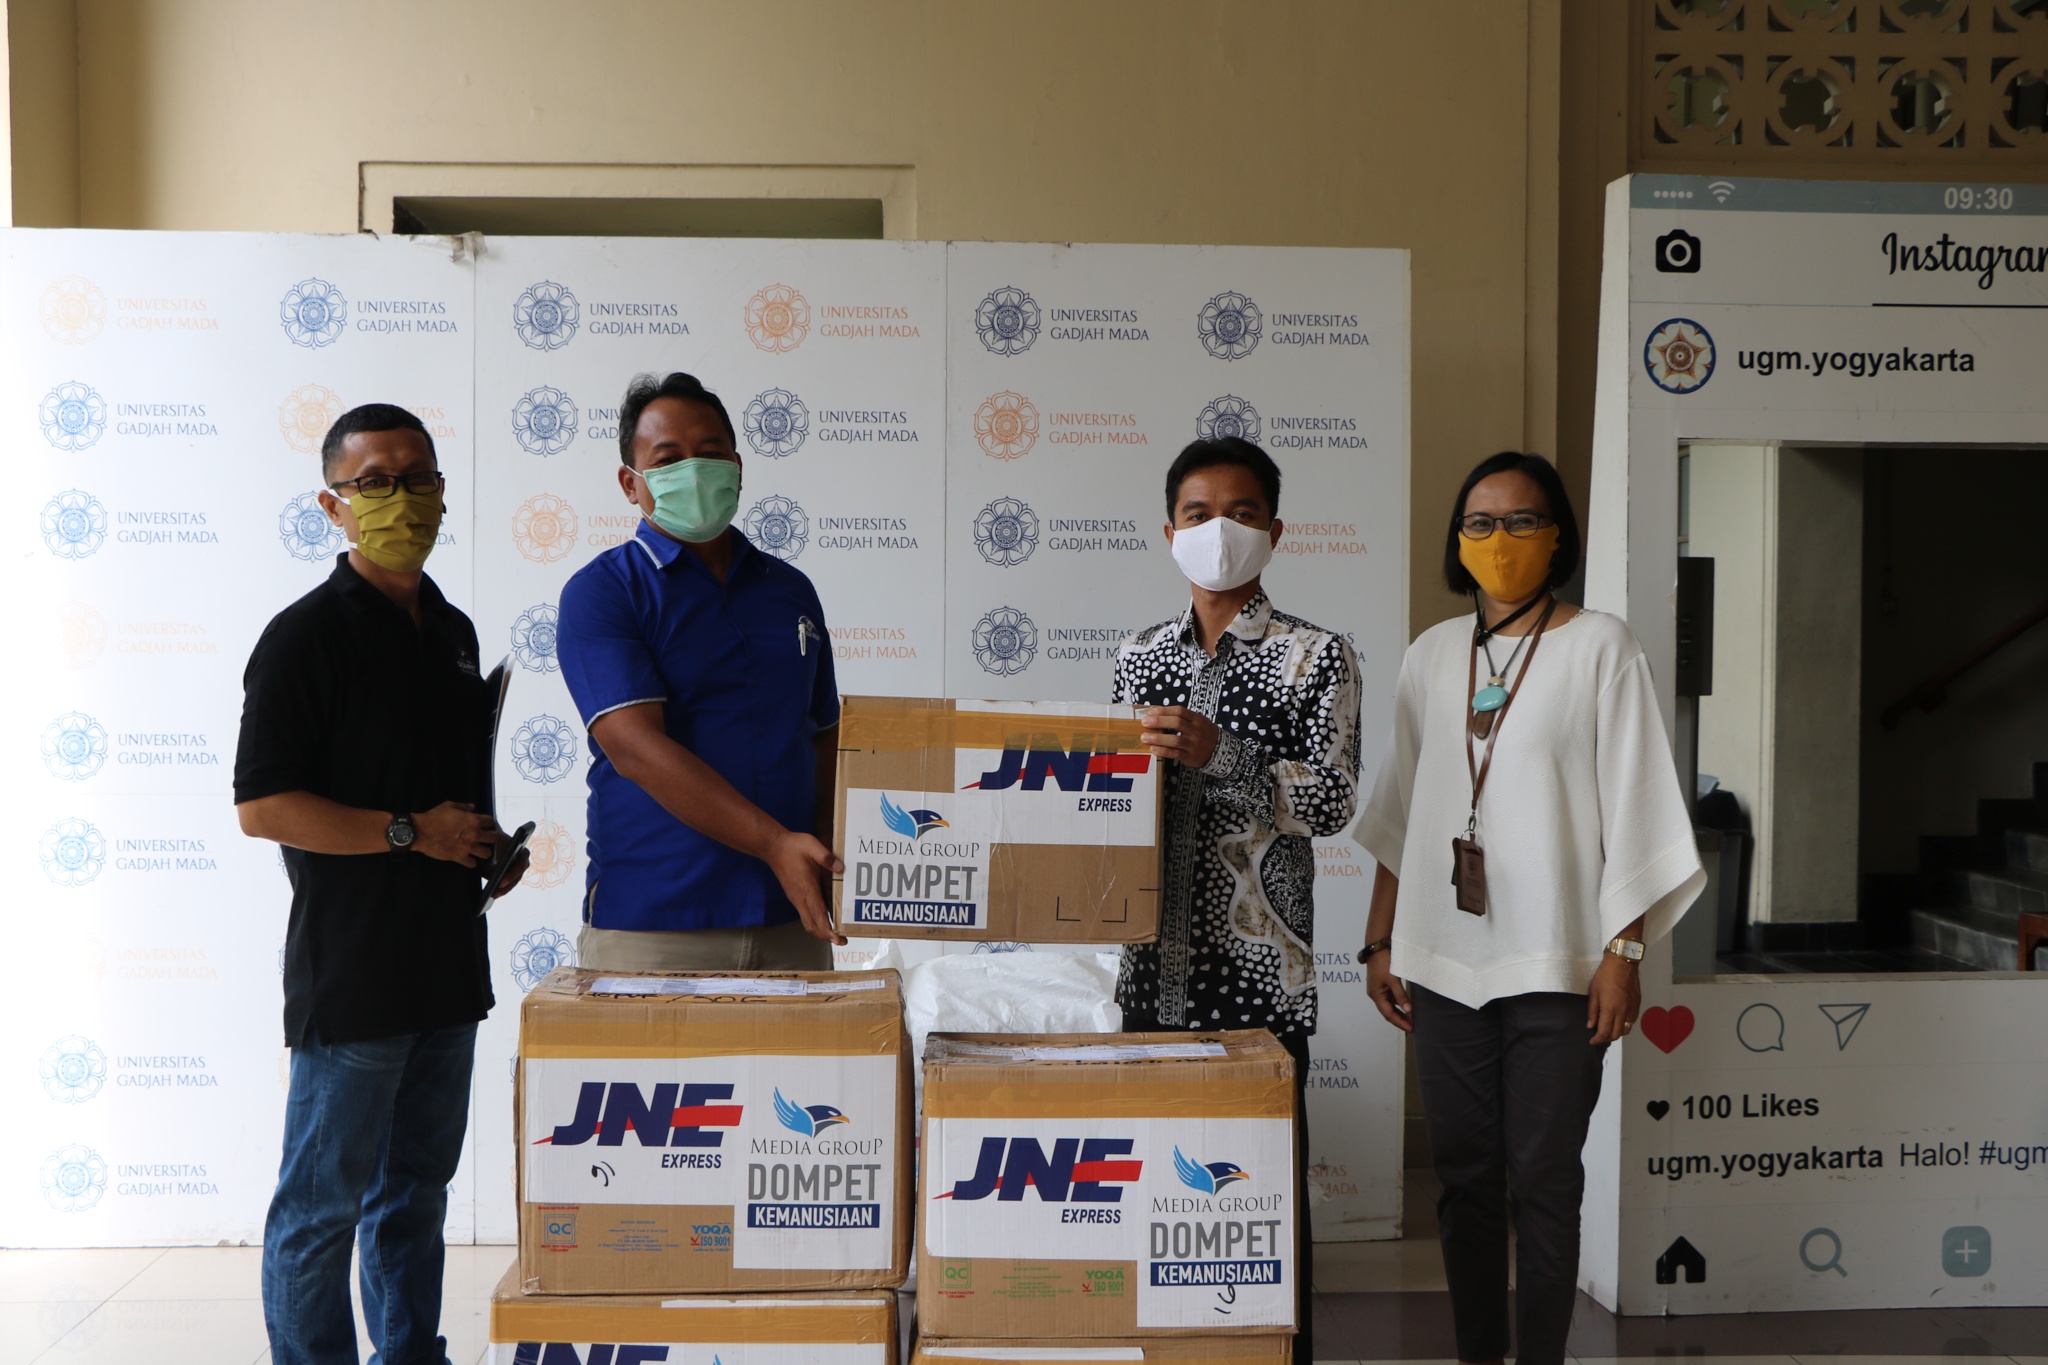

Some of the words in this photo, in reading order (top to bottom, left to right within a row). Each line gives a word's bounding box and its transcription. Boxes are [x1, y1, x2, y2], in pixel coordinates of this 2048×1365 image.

[1944, 187, 2013, 210] 09:30
[117, 298, 207, 313] UNIVERSITAS
[357, 301, 446, 314] UNIVERSITAS
[590, 303, 678, 317] UNIVERSITAS
[820, 306, 909, 320] UNIVERSITAS
[117, 316, 172, 331] GADJAH
[178, 316, 219, 331] MADA
[1051, 309, 1138, 323] UNIVERSITAS
[1272, 313, 1358, 328] UNIVERSITAS
[356, 319, 412, 335] GADJAH
[416, 319, 458, 333] MADA
[589, 321, 644, 337] GADJAH
[649, 322, 690, 335] MADA
[819, 323, 874, 339] GADJAH
[879, 324, 920, 338] MADA
[1050, 326, 1104, 343] GADJAH
[1109, 327, 1150, 341] MADA
[1271, 331, 1325, 347] GADJAH
[1329, 332, 1370, 346] MADA
[1738, 347, 1975, 377] ugm.yogyakarta
[117, 404, 206, 417] UNIVERSITAS
[819, 410, 907, 424] UNIVERSITAS
[1049, 413, 1137, 427] UNIVERSITAS
[1271, 417, 1357, 431] UNIVERSITAS
[116, 422, 172, 437] GADJAH
[177, 422, 218, 436] MADA
[427, 425, 457, 438] ADA
[818, 428, 873, 444] GADJAH
[878, 429, 919, 442] MADA
[1048, 431, 1103, 447] GADJAH
[1107, 431, 1148, 445] MADA
[1270, 434, 1323, 451] GADJAH
[1328, 436, 1368, 449] MADA
[118, 511, 207, 525] UNIVERSITAS
[588, 515, 639, 528] UNIVER
[819, 517, 907, 531] UNIVERSITAS
[1049, 519, 1136, 533] UNIVERSITAS
[1279, 523, 1357, 536] NIVERSITAS
[117, 530, 173, 545] GADJAH
[177, 530, 219, 544] MADA
[818, 535, 873, 551] GADJAH
[877, 536, 919, 549] MADA
[1048, 537, 1102, 553] GADJAH
[1107, 538, 1148, 551] MADA
[1327, 541, 1368, 555] MADA
[117, 622, 206, 635] UNIVERSITAS
[828, 627, 905, 641] NIVERSITAS
[117, 640, 172, 655] GADJAH
[177, 640, 218, 655] MADA
[832, 645, 870, 661] ADJAH
[876, 646, 917, 659] MADA
[1047, 646, 1101, 662] GADJAH
[118, 733, 207, 747] UNIVERSITAS
[117, 751, 173, 767] GADJAH
[177, 751, 219, 765] MADA
[979, 732, 1151, 792] JNE
[1078, 798, 1132, 812] EXPRESS
[116, 839, 206, 852] UNIVERSITAS
[858, 838, 914, 856] MEDIA
[921, 843, 980, 858] GROUP
[115, 857, 171, 873] GADJAH
[176, 857, 217, 870] MADA
[1323, 864, 1363, 877] MADA
[855, 862, 978, 901] DOMPET
[861, 902, 969, 923] KEMANUSIAAN
[1321, 970, 1362, 983] MADA
[117, 1055, 206, 1069] UNIVERSITAS
[116, 1073, 172, 1089] GADJAH
[176, 1074, 218, 1087] MADA
[1319, 1076, 1359, 1089] MADA
[552, 1082, 744, 1147] JNE
[1682, 1095, 1731, 1120] 100
[1743, 1094, 1819, 1118] Likes
[751, 1137, 812, 1156] MEDIA
[819, 1138, 883, 1155] GROUP
[661, 1154, 722, 1169] EXPRESS
[1648, 1146, 1883, 1181] ugm.yogyakarta
[1900, 1142, 1969, 1167] Halo!
[118, 1164, 207, 1177] UNIVERSITAS
[952, 1137, 1143, 1202] JNE
[117, 1182, 173, 1198] GADJAH
[177, 1182, 219, 1195] MADA
[748, 1164, 881, 1201] DOMPET
[1152, 1196, 1214, 1213] MEDIA
[1220, 1194, 1282, 1211] GROUP
[756, 1208, 872, 1227] KEMANUSIAAN
[1061, 1208, 1121, 1224] EXPRESS
[548, 1223, 572, 1236] QC
[692, 1225, 731, 1234] YOQA
[701, 1236, 712, 1246] ISO
[714, 1236, 730, 1246] 9001
[1150, 1220, 1281, 1259] DOMPET
[945, 1267, 967, 1280] QC
[1085, 1270, 1125, 1280] YOQA
[1158, 1264, 1274, 1284] KEMANUSIAAN
[1094, 1282, 1106, 1291] ISO
[1108, 1282, 1124, 1291] 9001
